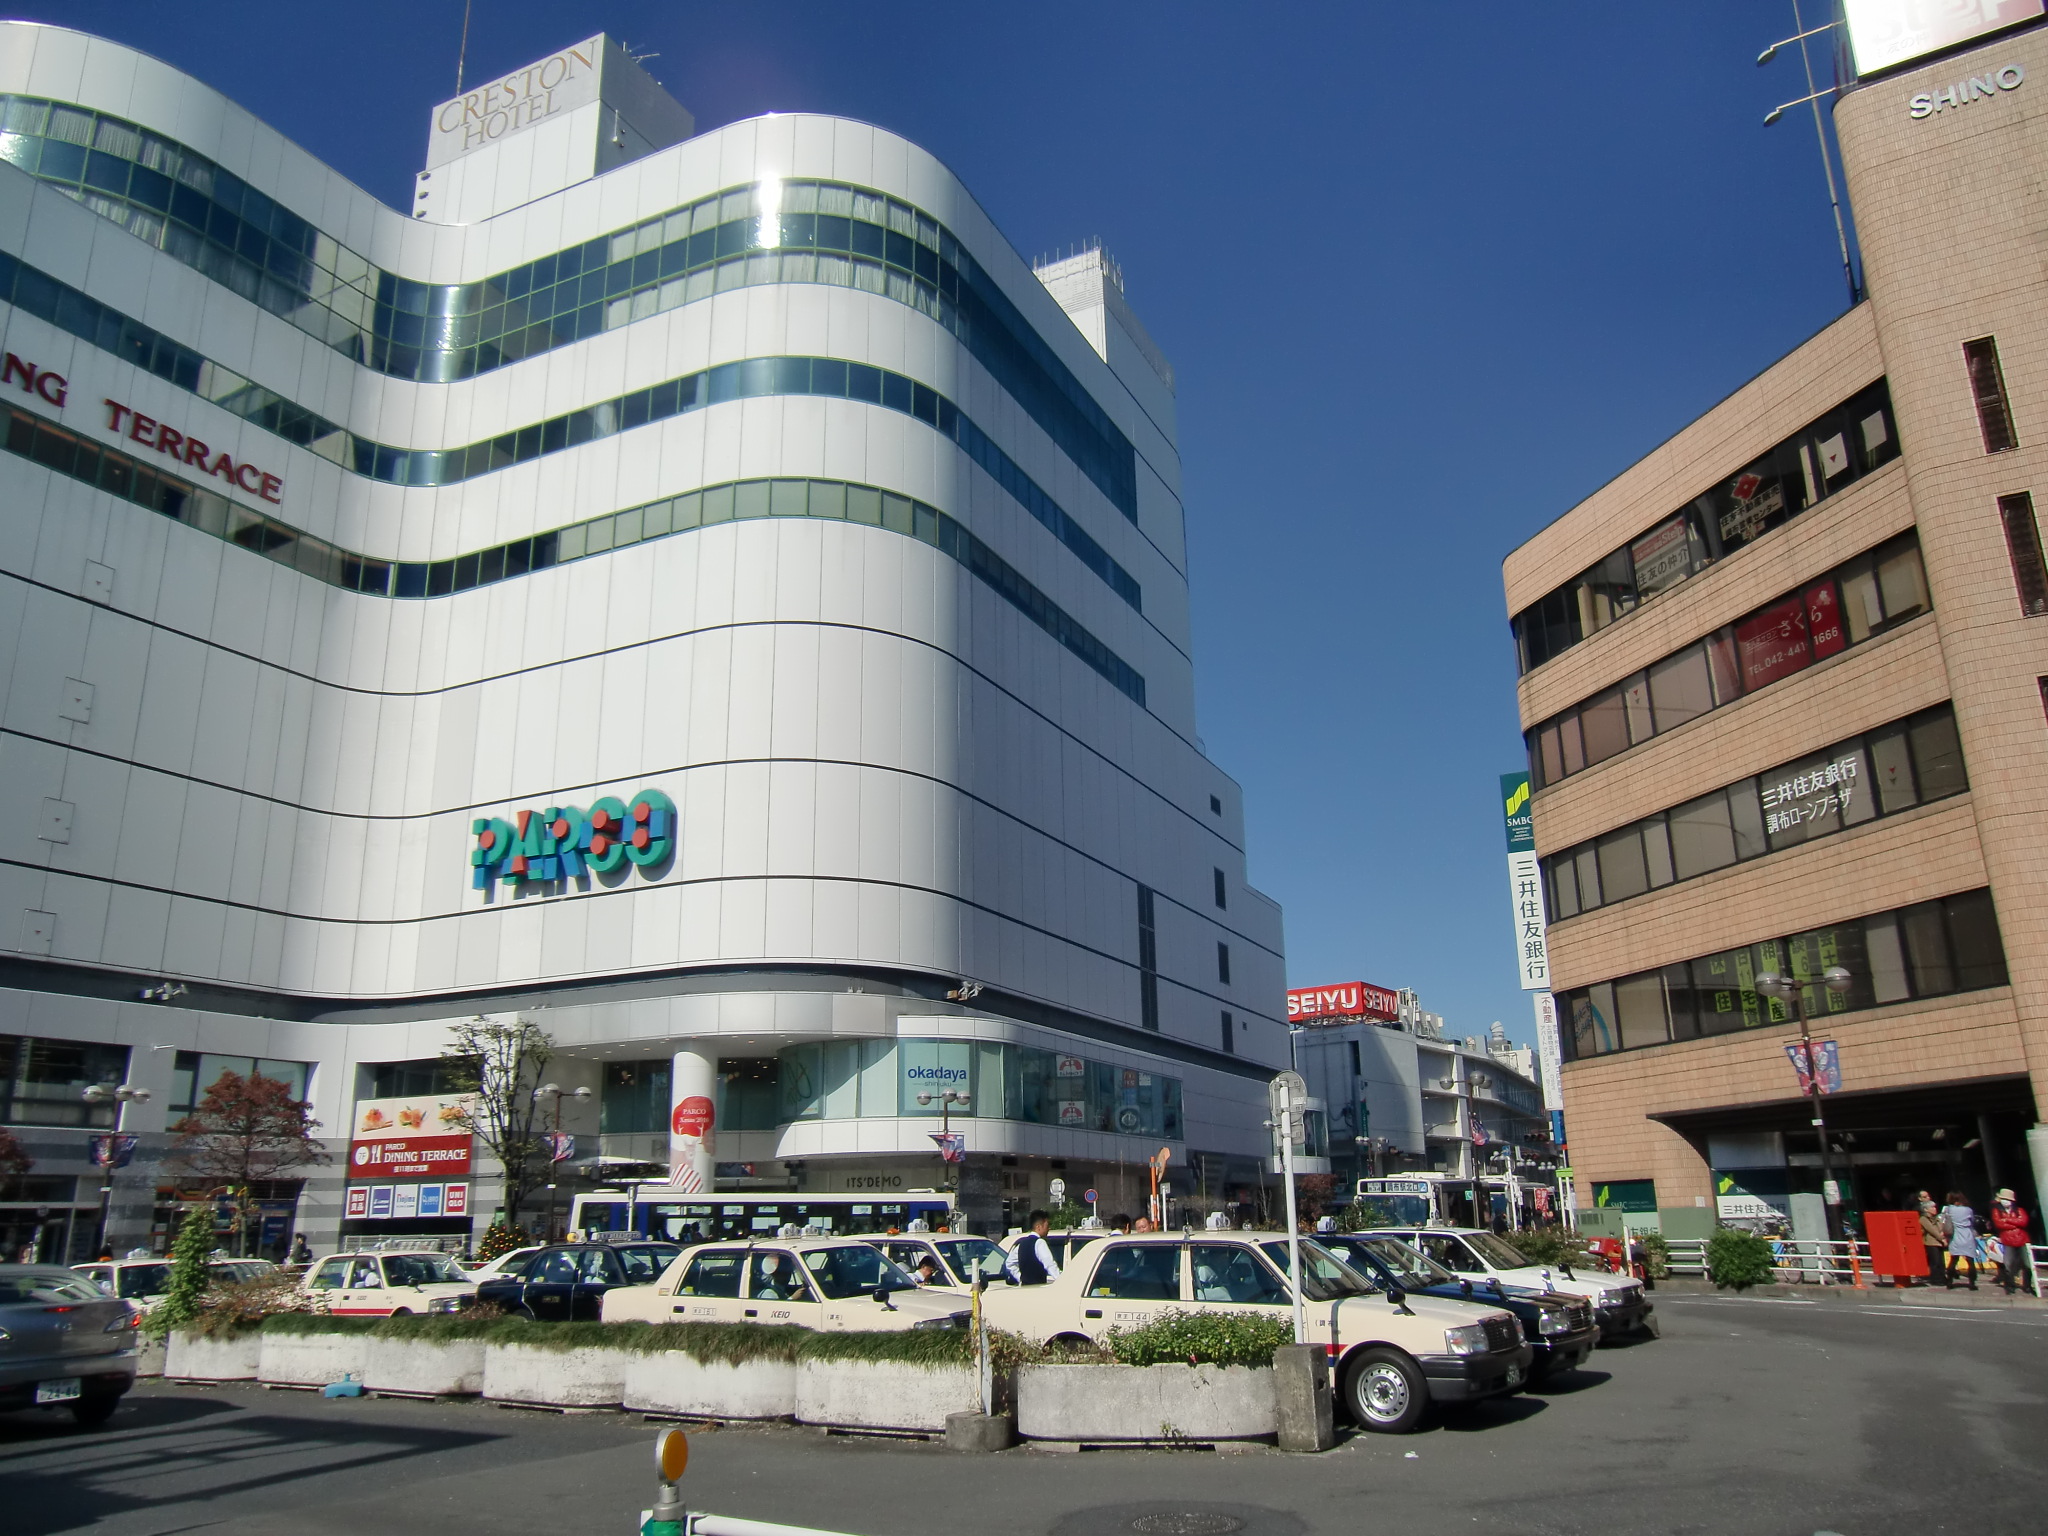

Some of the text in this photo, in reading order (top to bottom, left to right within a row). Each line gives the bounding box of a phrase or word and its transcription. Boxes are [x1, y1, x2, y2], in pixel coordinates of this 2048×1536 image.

[438, 40, 598, 134] CRESTON
[1909, 63, 2026, 119] SHINO
[462, 89, 562, 151] HOTEL
[2, 352, 283, 504] NG TERRACE
[1761, 757, 1857, 809] 三井住友銀行
[1507, 815, 1533, 827] SMBC
[1766, 788, 1852, 834] 調布ローンプラザ
[471, 788, 679, 890] PARCO
[1517, 860, 1546, 980] 三井住友銀行
[1288, 987, 1357, 1016] SEIYU
[1363, 986, 1398, 1015] SEIYU
[908, 1066, 967, 1083] okadaya
[383, 1149, 467, 1163] DINING TERRACE
[449, 1191, 464, 1199] UNI
[771, 1310, 791, 1319] KEIO
